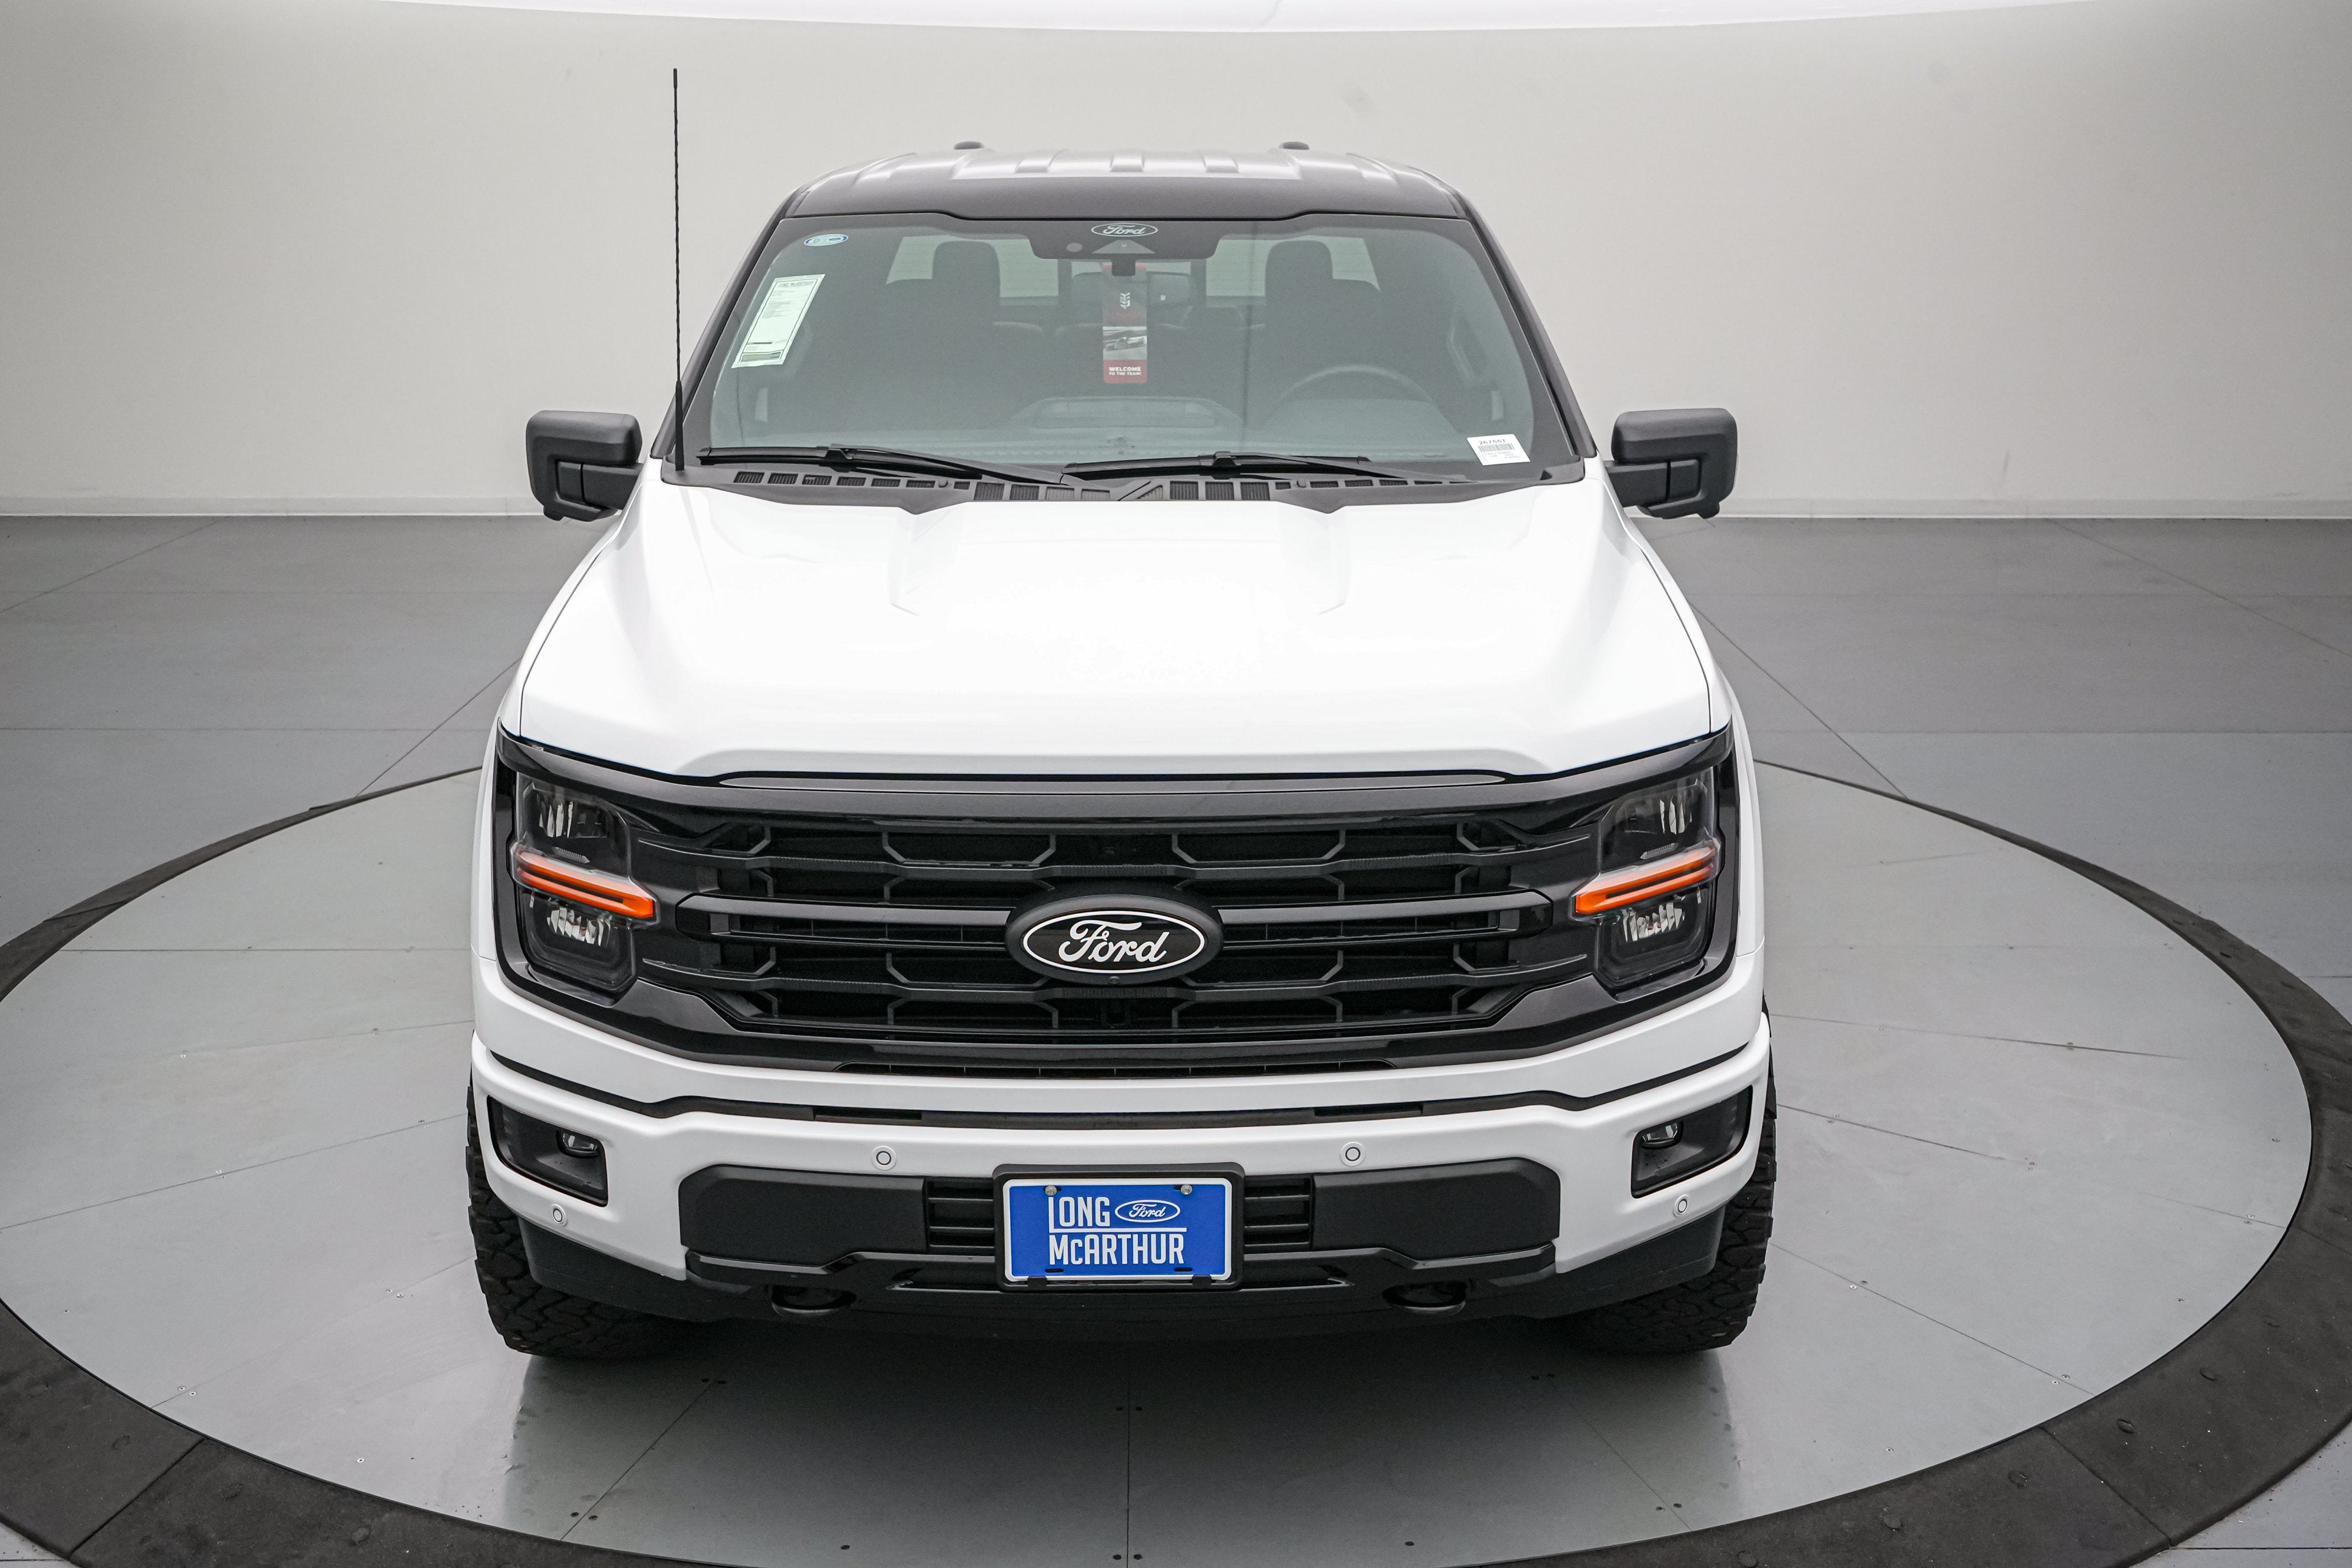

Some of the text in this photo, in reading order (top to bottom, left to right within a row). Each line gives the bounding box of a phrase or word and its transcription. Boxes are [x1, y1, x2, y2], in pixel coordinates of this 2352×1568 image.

[1103, 225, 1146, 235] Ford
[1058, 920, 1170, 962] Ford
[1048, 1196, 1167, 1233] LONG Ford
[1049, 1233, 1184, 1265] McARTHUR
